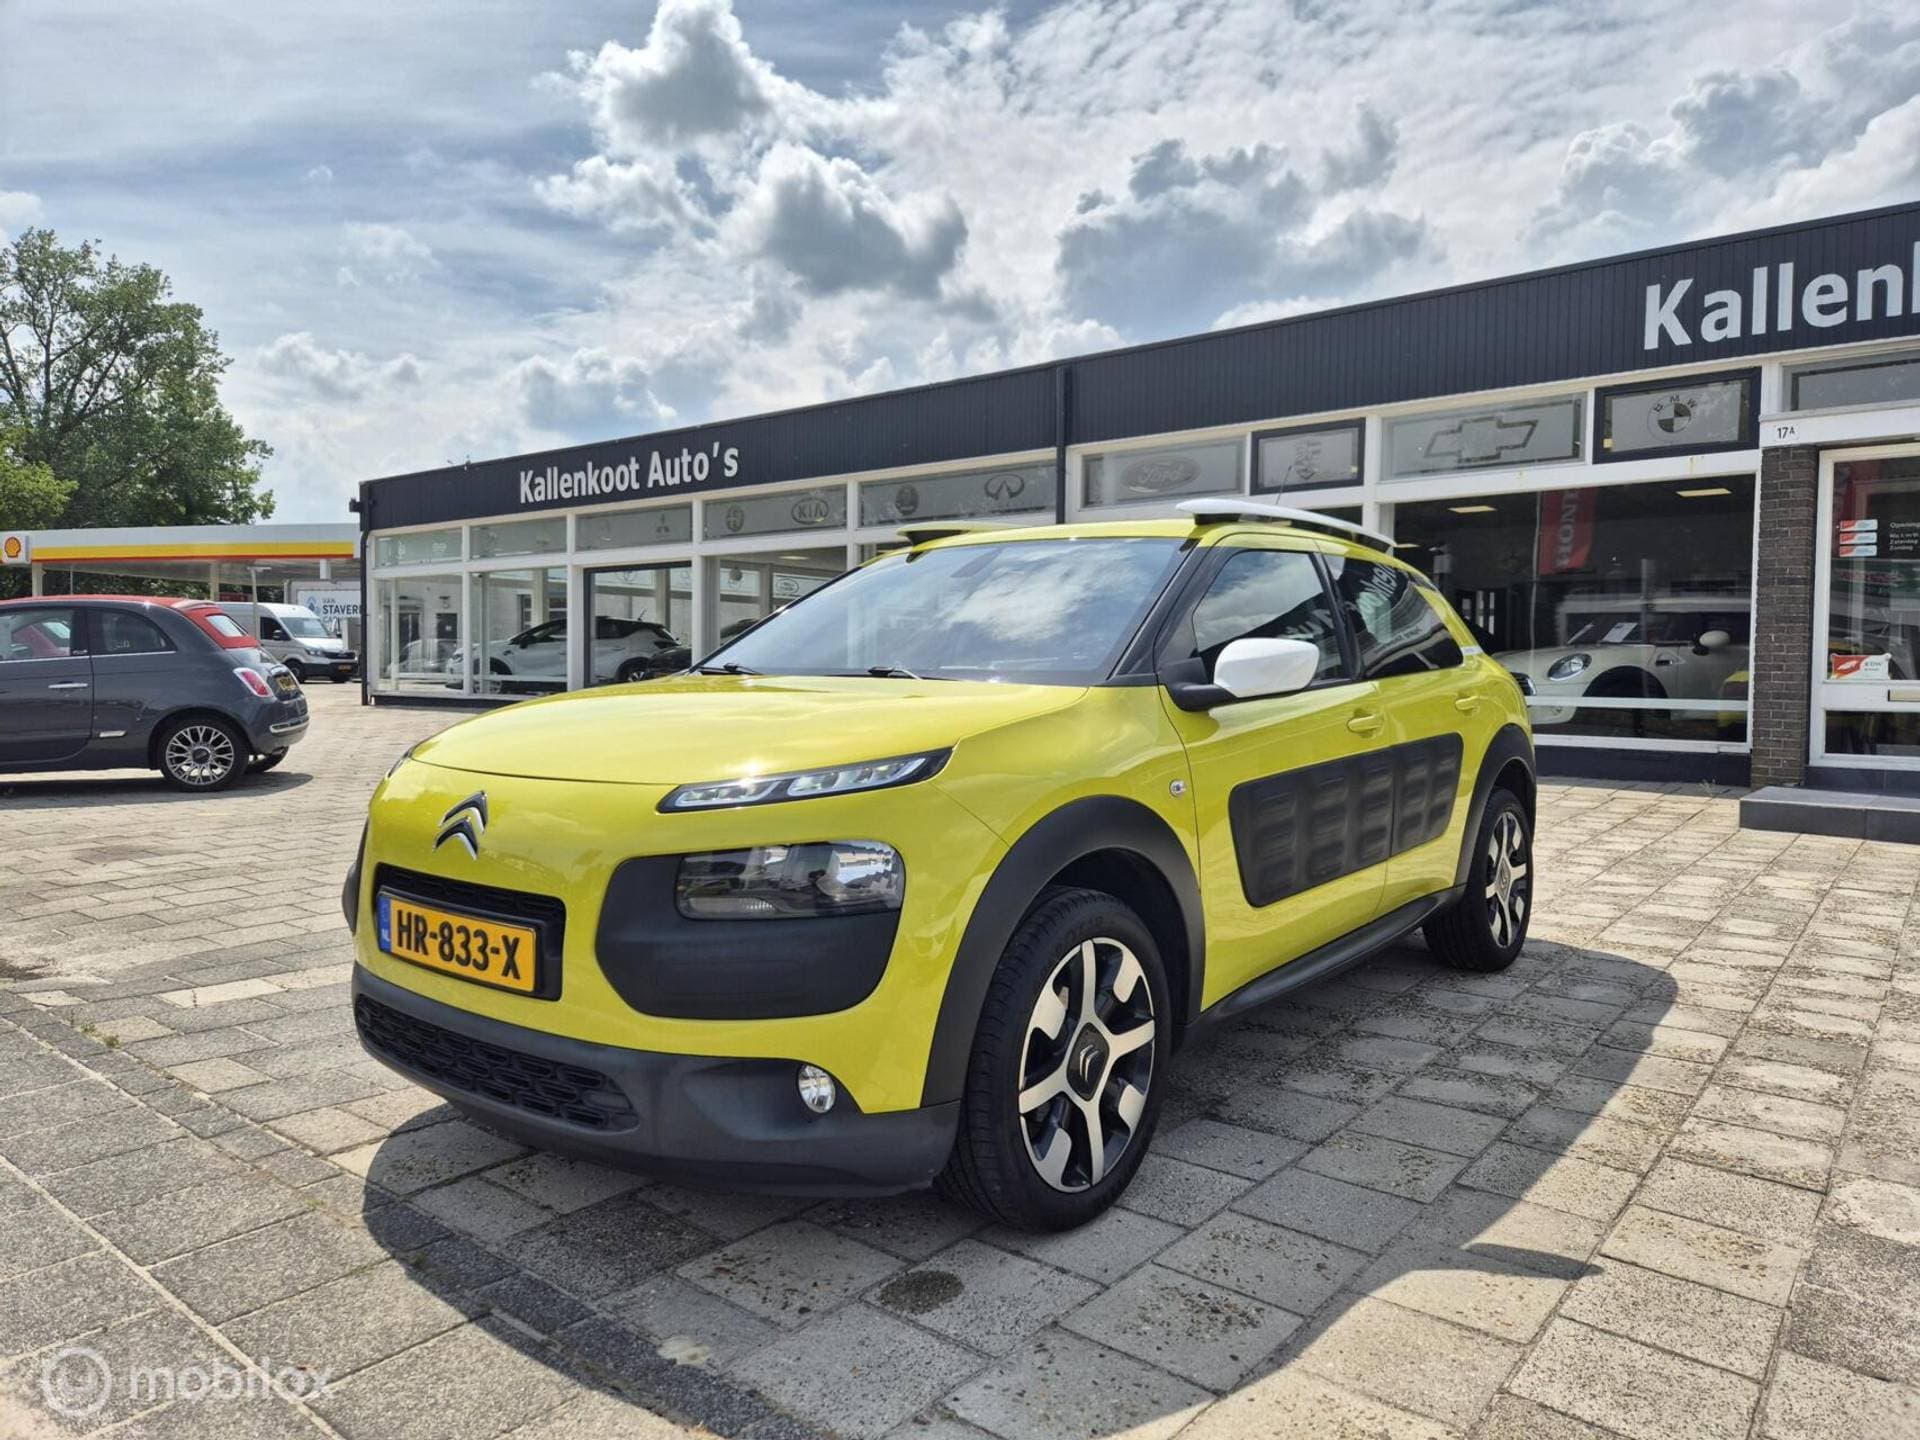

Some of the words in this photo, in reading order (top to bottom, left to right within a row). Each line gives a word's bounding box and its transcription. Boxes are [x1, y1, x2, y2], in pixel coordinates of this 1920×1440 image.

[1643, 240, 1920, 351] Kallen
[519, 456, 640, 504] Kallenkoot
[647, 441, 739, 488] Auto's
[797, 502, 825, 519] KIA
[322, 605, 362, 615] STAVER
[396, 909, 521, 981] HR-833-X
